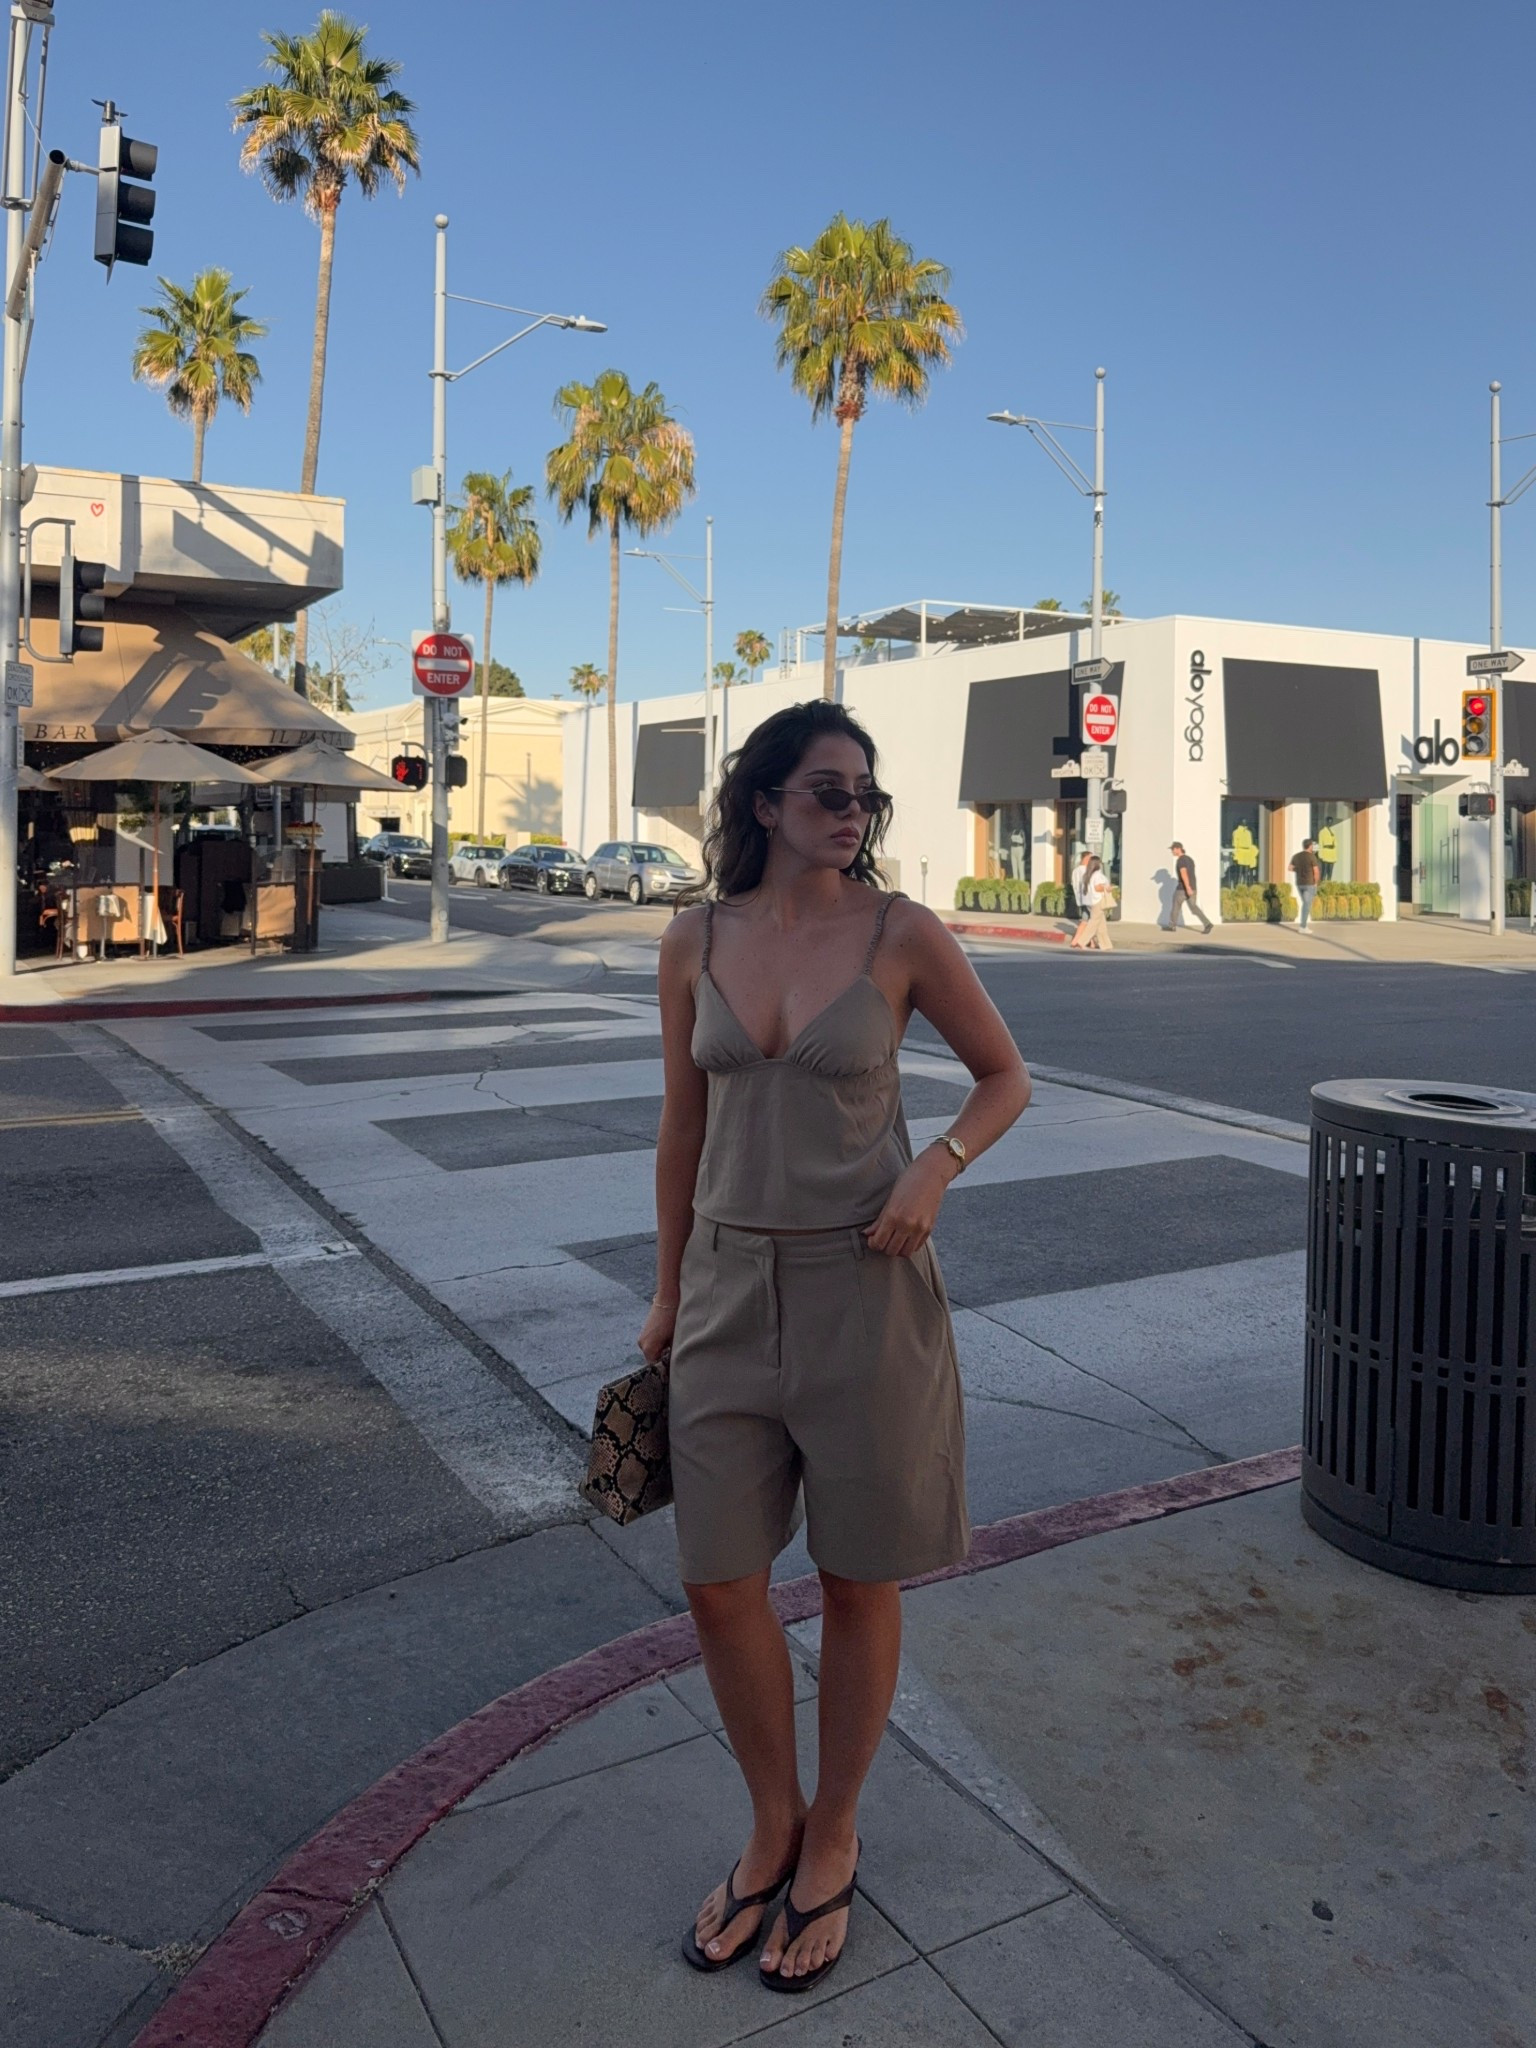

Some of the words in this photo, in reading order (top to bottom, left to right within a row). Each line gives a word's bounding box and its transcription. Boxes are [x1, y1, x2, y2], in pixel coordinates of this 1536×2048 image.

[422, 643, 437, 656] DO
[443, 645, 463, 657] NOT
[1077, 667, 1088, 676] ONE
[1089, 665, 1101, 674] WAY
[1472, 660, 1488, 669] ONE
[1490, 658, 1507, 667] WAY
[1190, 649, 1212, 693] alo
[427, 672, 460, 685] ENTER
[7, 686, 18, 701] OK
[1089, 703, 1098, 713] DO
[1100, 704, 1112, 714] NOT
[34, 723, 87, 740] BAR
[1091, 725, 1110, 735] ENTER
[1184, 692, 1204, 762] yoga
[269, 729, 288, 744] IL
[1413, 718, 1460, 767] alo
